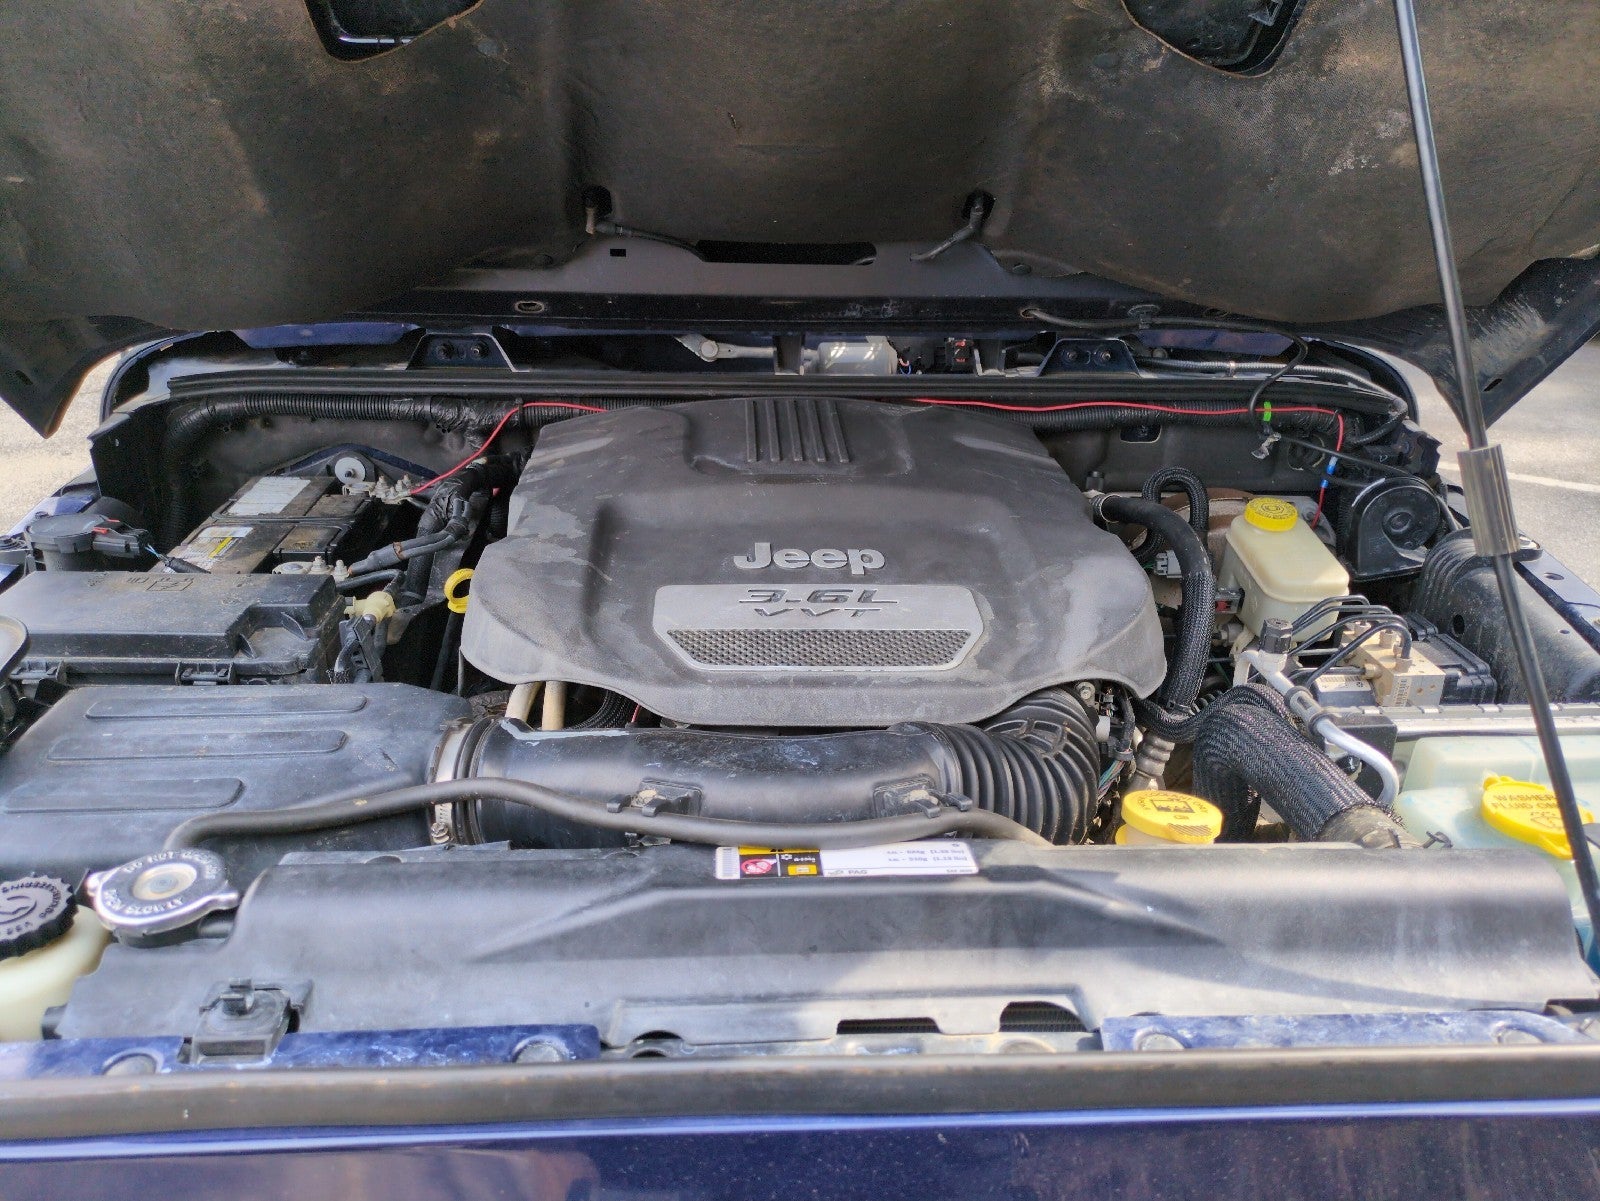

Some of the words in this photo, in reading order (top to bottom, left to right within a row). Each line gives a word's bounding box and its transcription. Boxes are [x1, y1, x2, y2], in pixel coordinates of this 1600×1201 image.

[733, 541, 886, 575] Jeep
[738, 588, 898, 604] 3.6L
[753, 607, 882, 618] VVT
